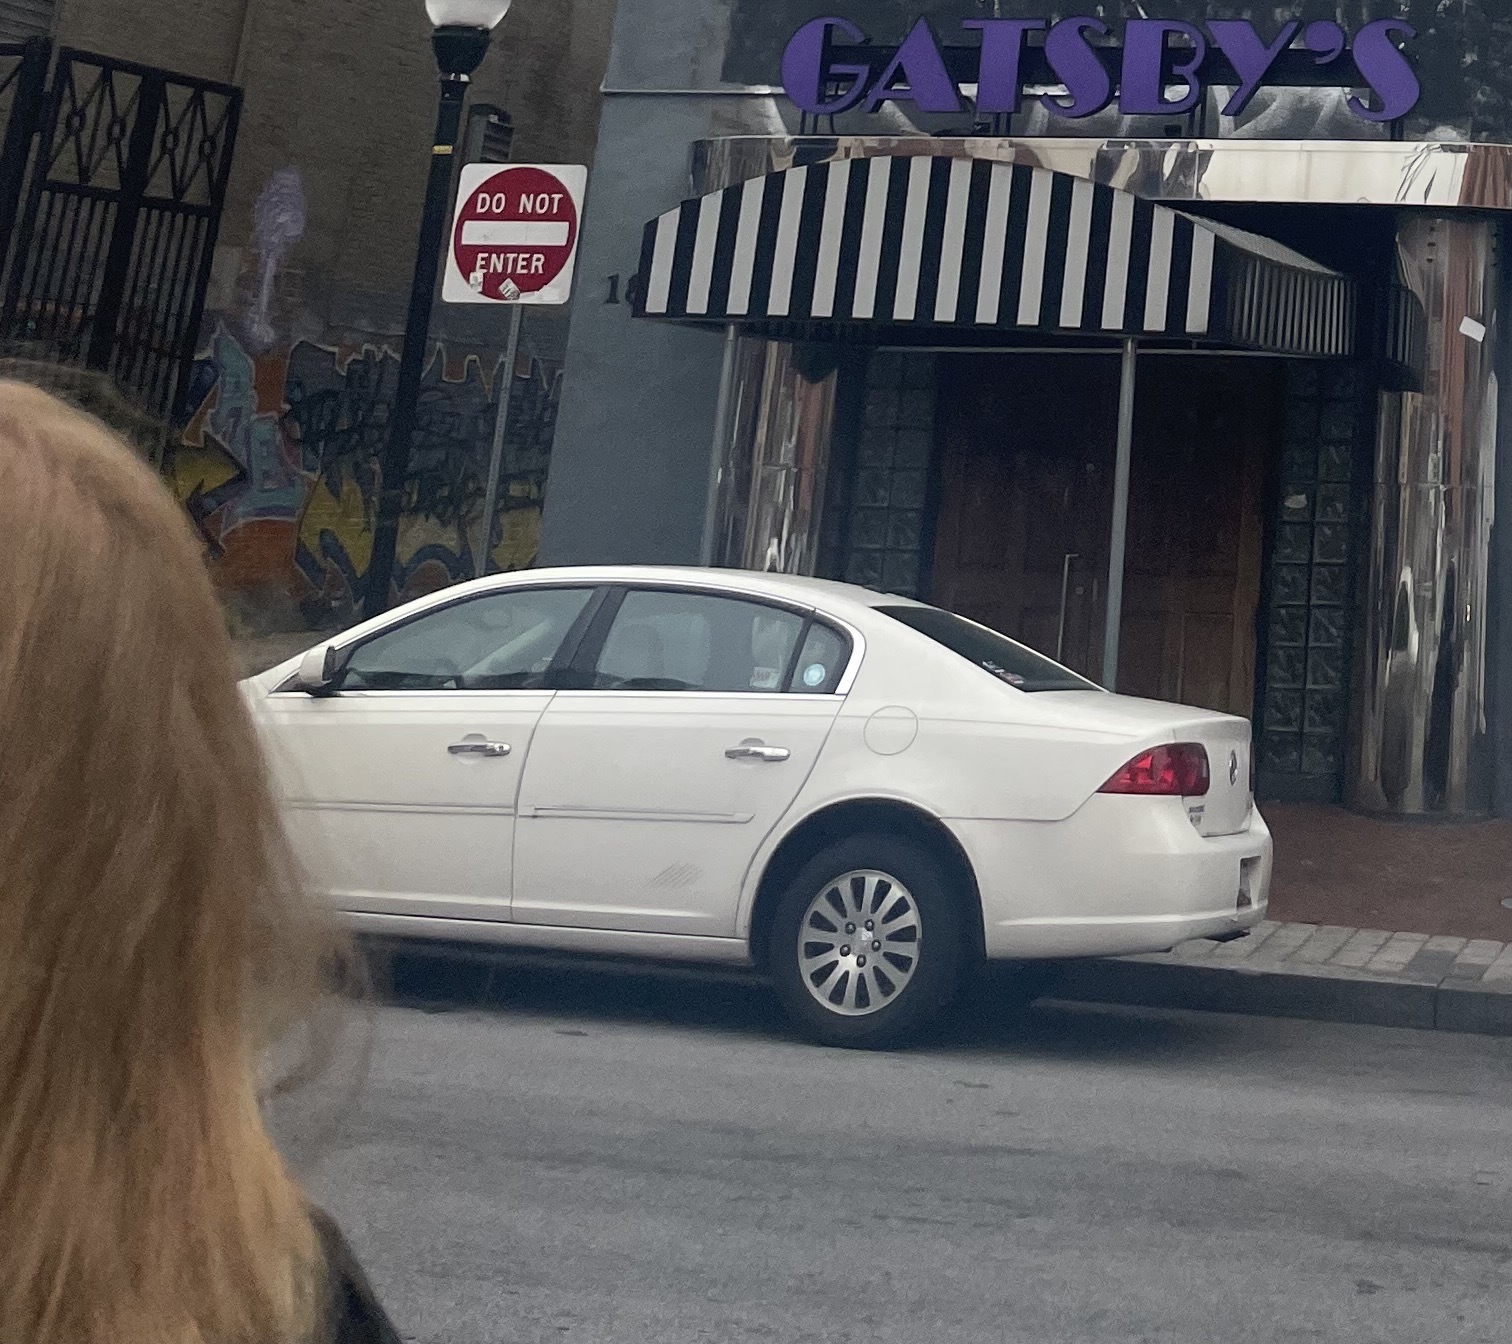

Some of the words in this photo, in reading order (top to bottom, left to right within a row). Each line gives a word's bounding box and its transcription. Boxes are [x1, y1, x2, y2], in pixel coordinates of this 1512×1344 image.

[781, 15, 1421, 123] GATSBY'S
[476, 192, 506, 214] DO
[518, 192, 564, 215] NOT
[475, 252, 545, 275] ENTER
